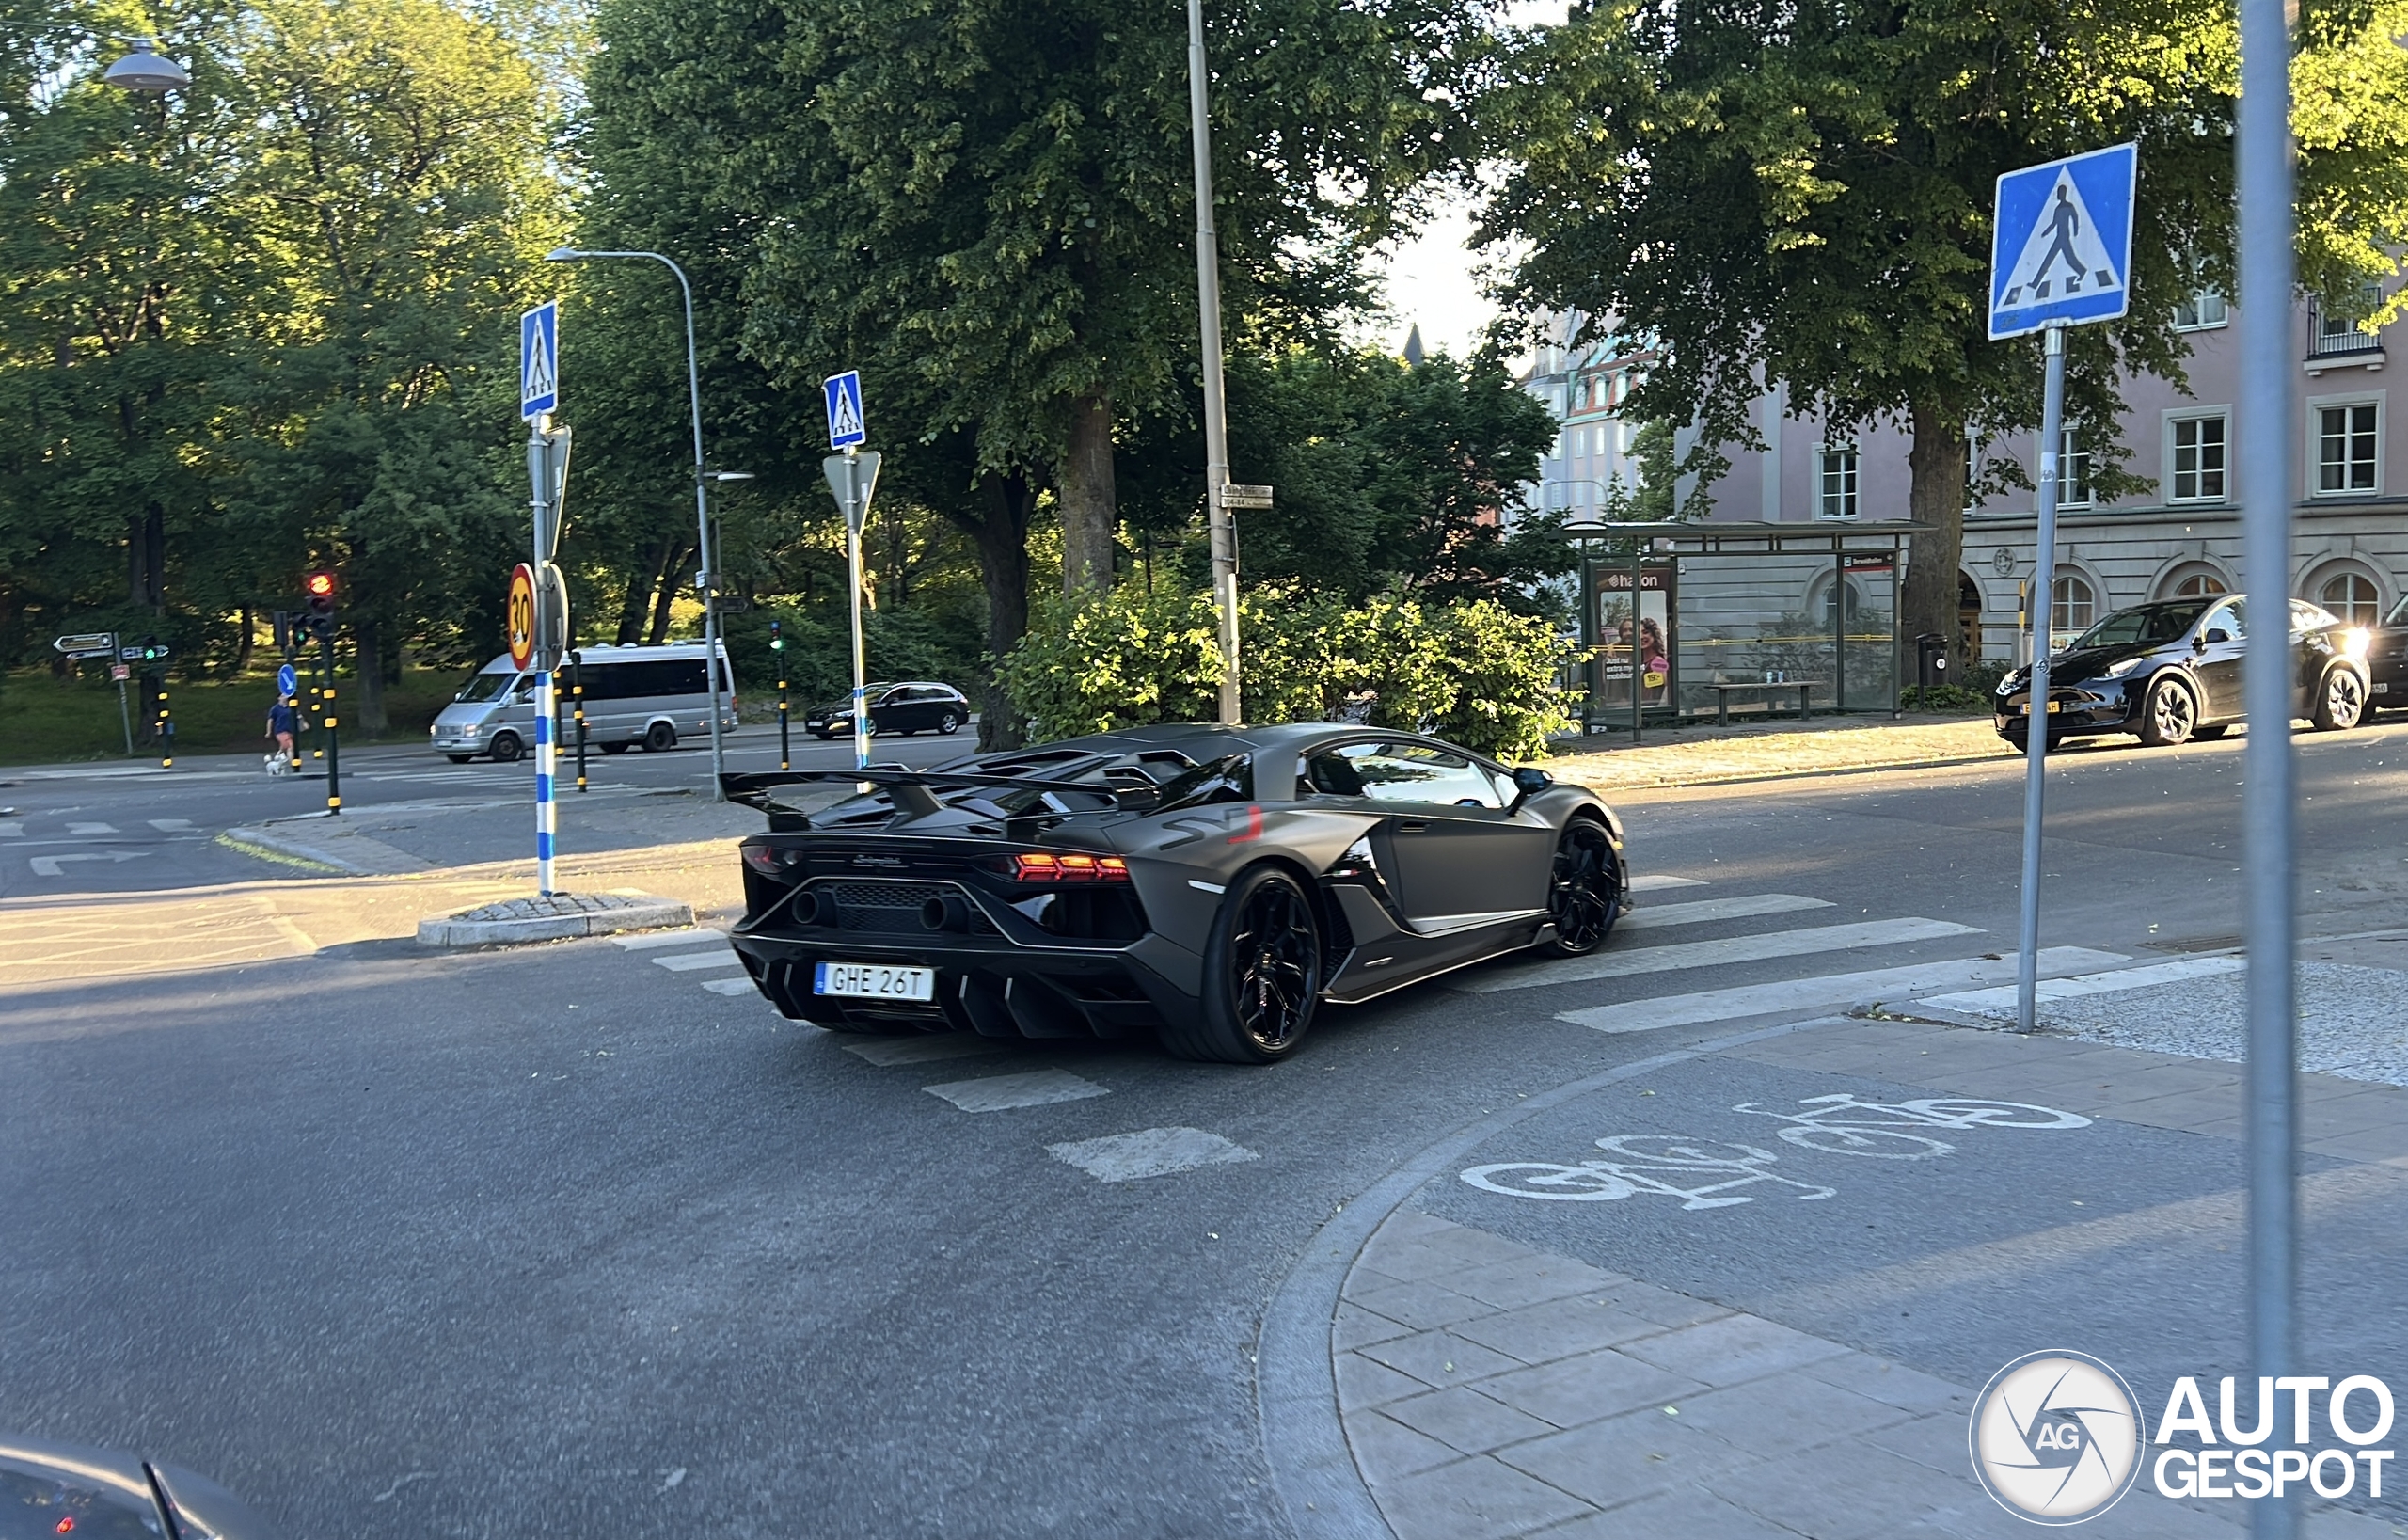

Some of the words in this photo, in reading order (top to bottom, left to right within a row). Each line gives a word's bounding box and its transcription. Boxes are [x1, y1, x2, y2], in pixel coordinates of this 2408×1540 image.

[1620, 575, 1658, 587] haon
[512, 593, 531, 643] 30
[832, 967, 871, 992] GHE
[879, 969, 922, 996] 26T
